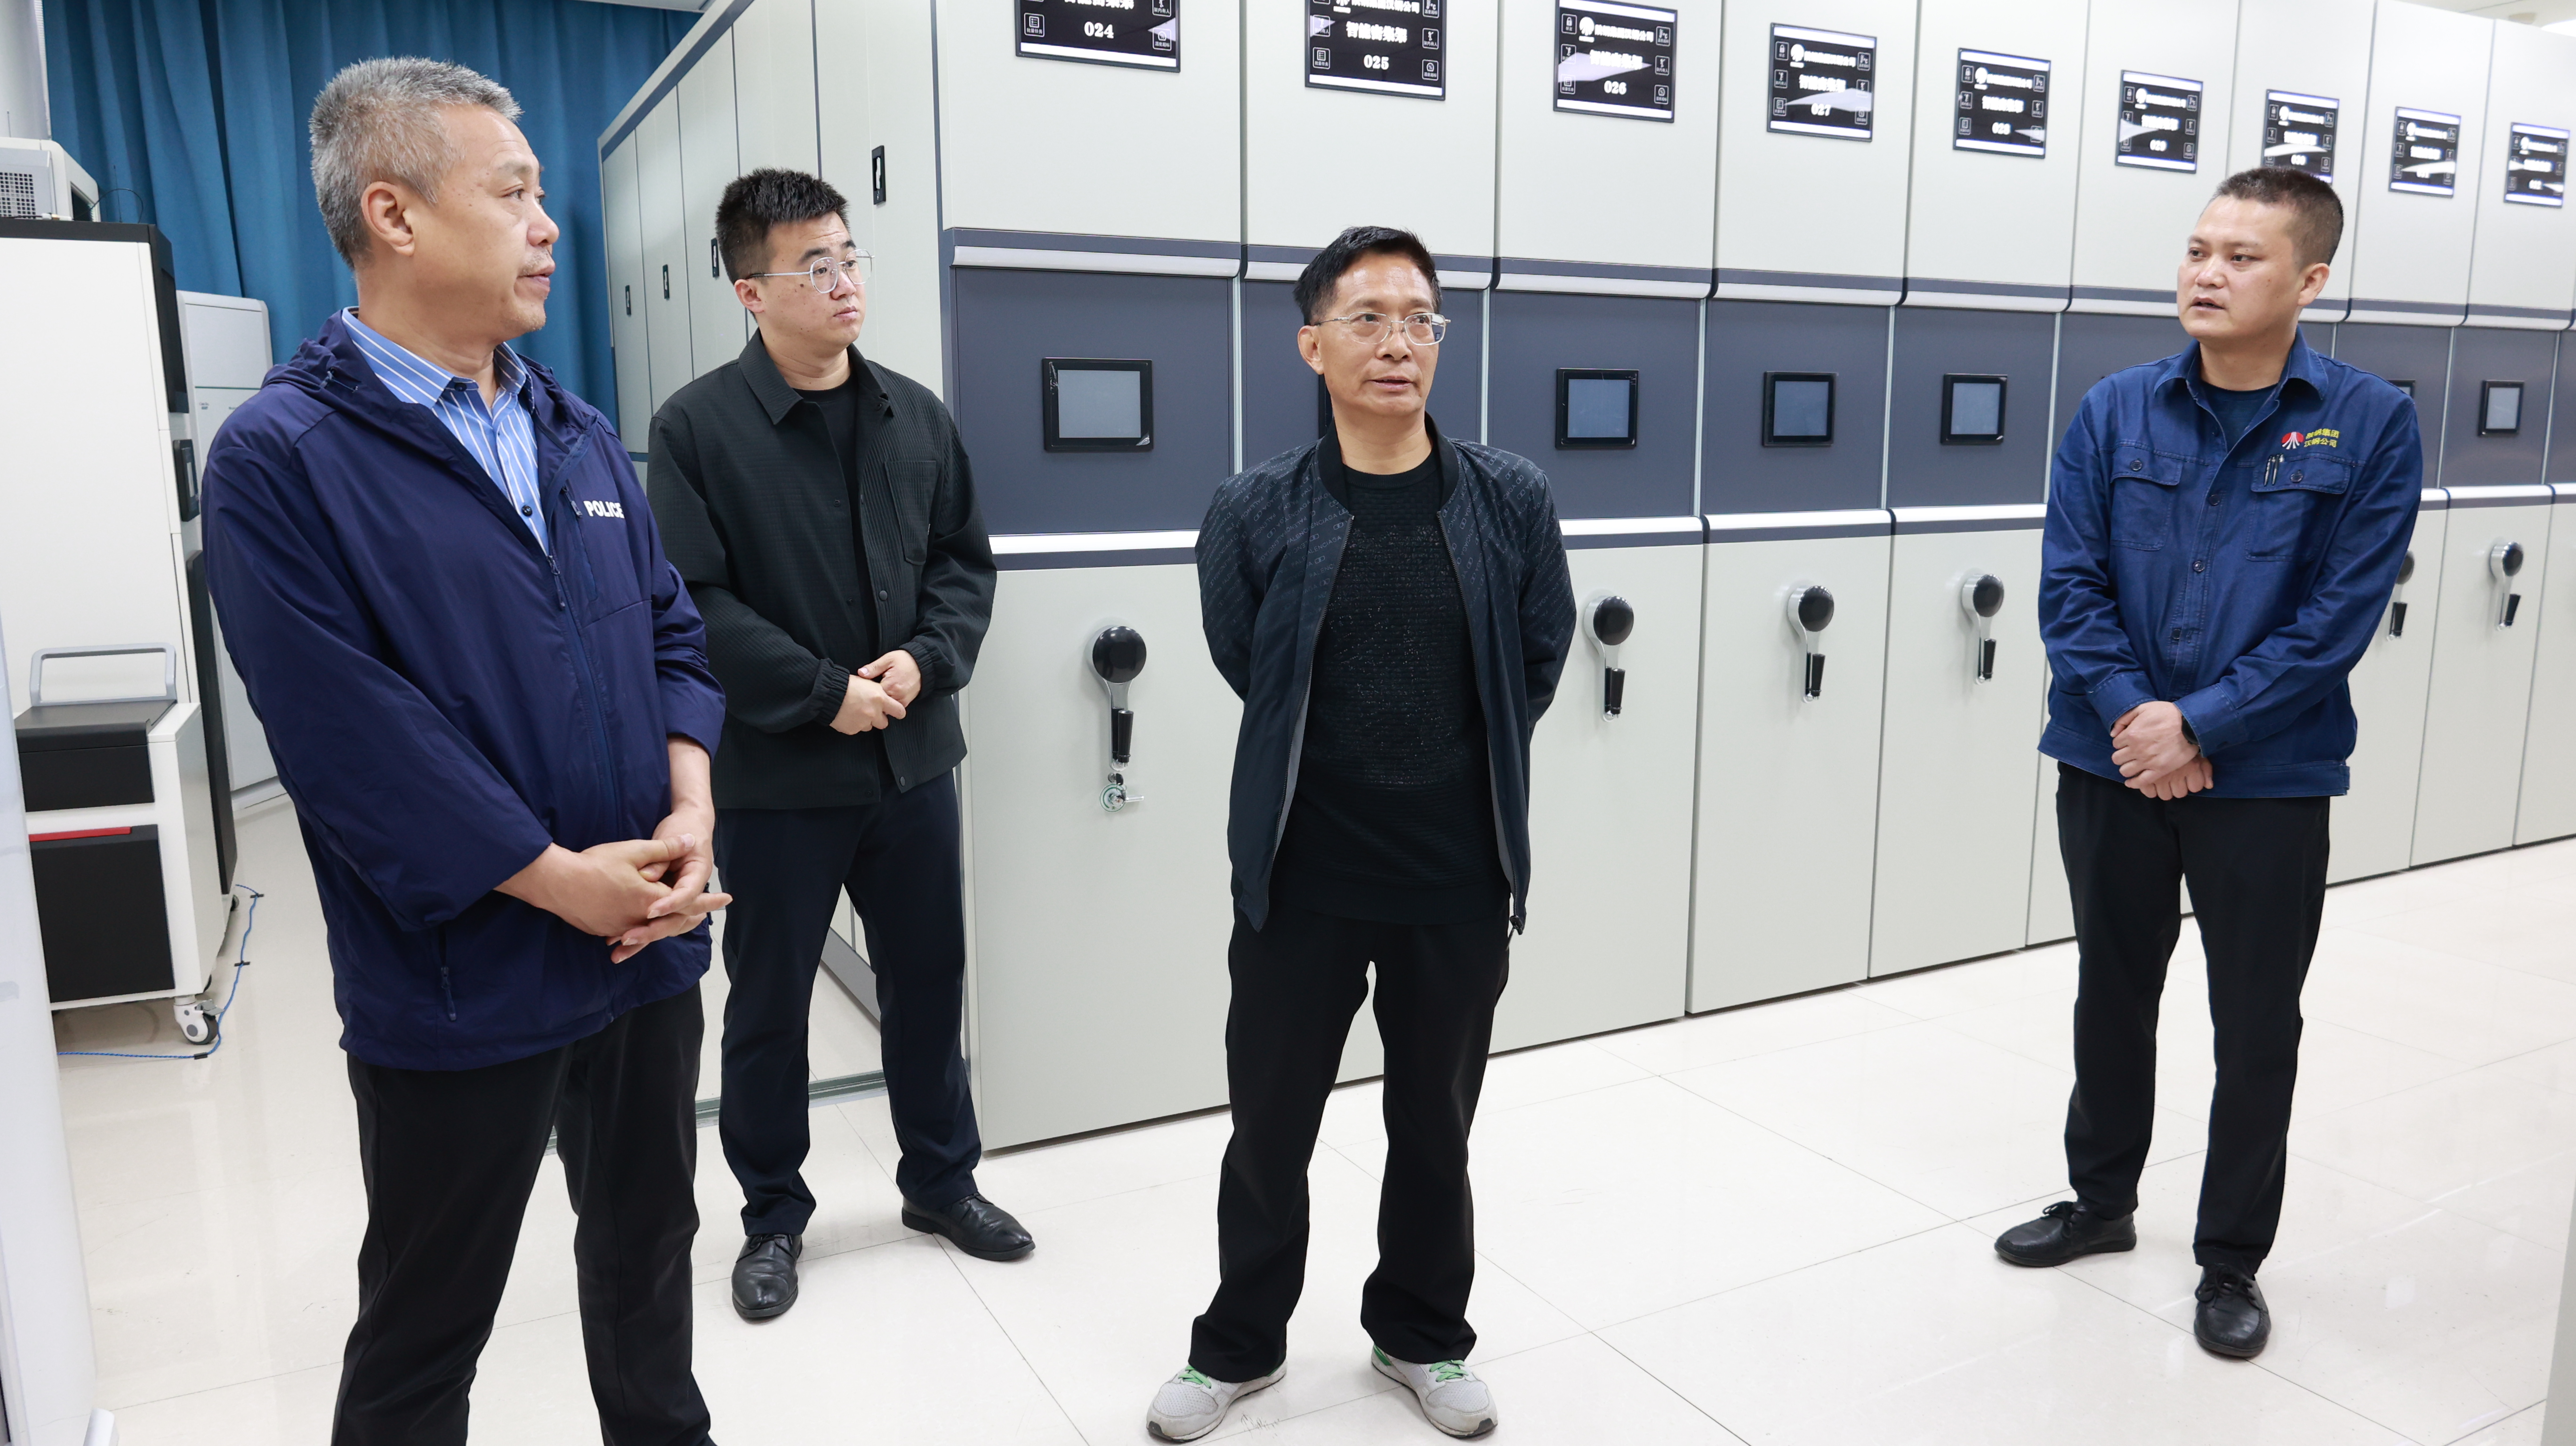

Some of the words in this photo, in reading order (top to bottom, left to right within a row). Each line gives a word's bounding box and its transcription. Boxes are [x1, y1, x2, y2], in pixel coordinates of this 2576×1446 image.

[1084, 21, 1114, 39] 024
[1363, 54, 1389, 70] 025
[1603, 80, 1627, 95] 026
[1811, 103, 1832, 117] 027
[1991, 122, 2012, 135] 028
[1253, 466, 1287, 493] PALENCIAGA
[1265, 466, 1298, 494] PALENCIAGA
[583, 500, 625, 519] POLICE
[1236, 496, 1264, 528] PALENCIAGA
[1258, 530, 1287, 563] PALENCIAGA
